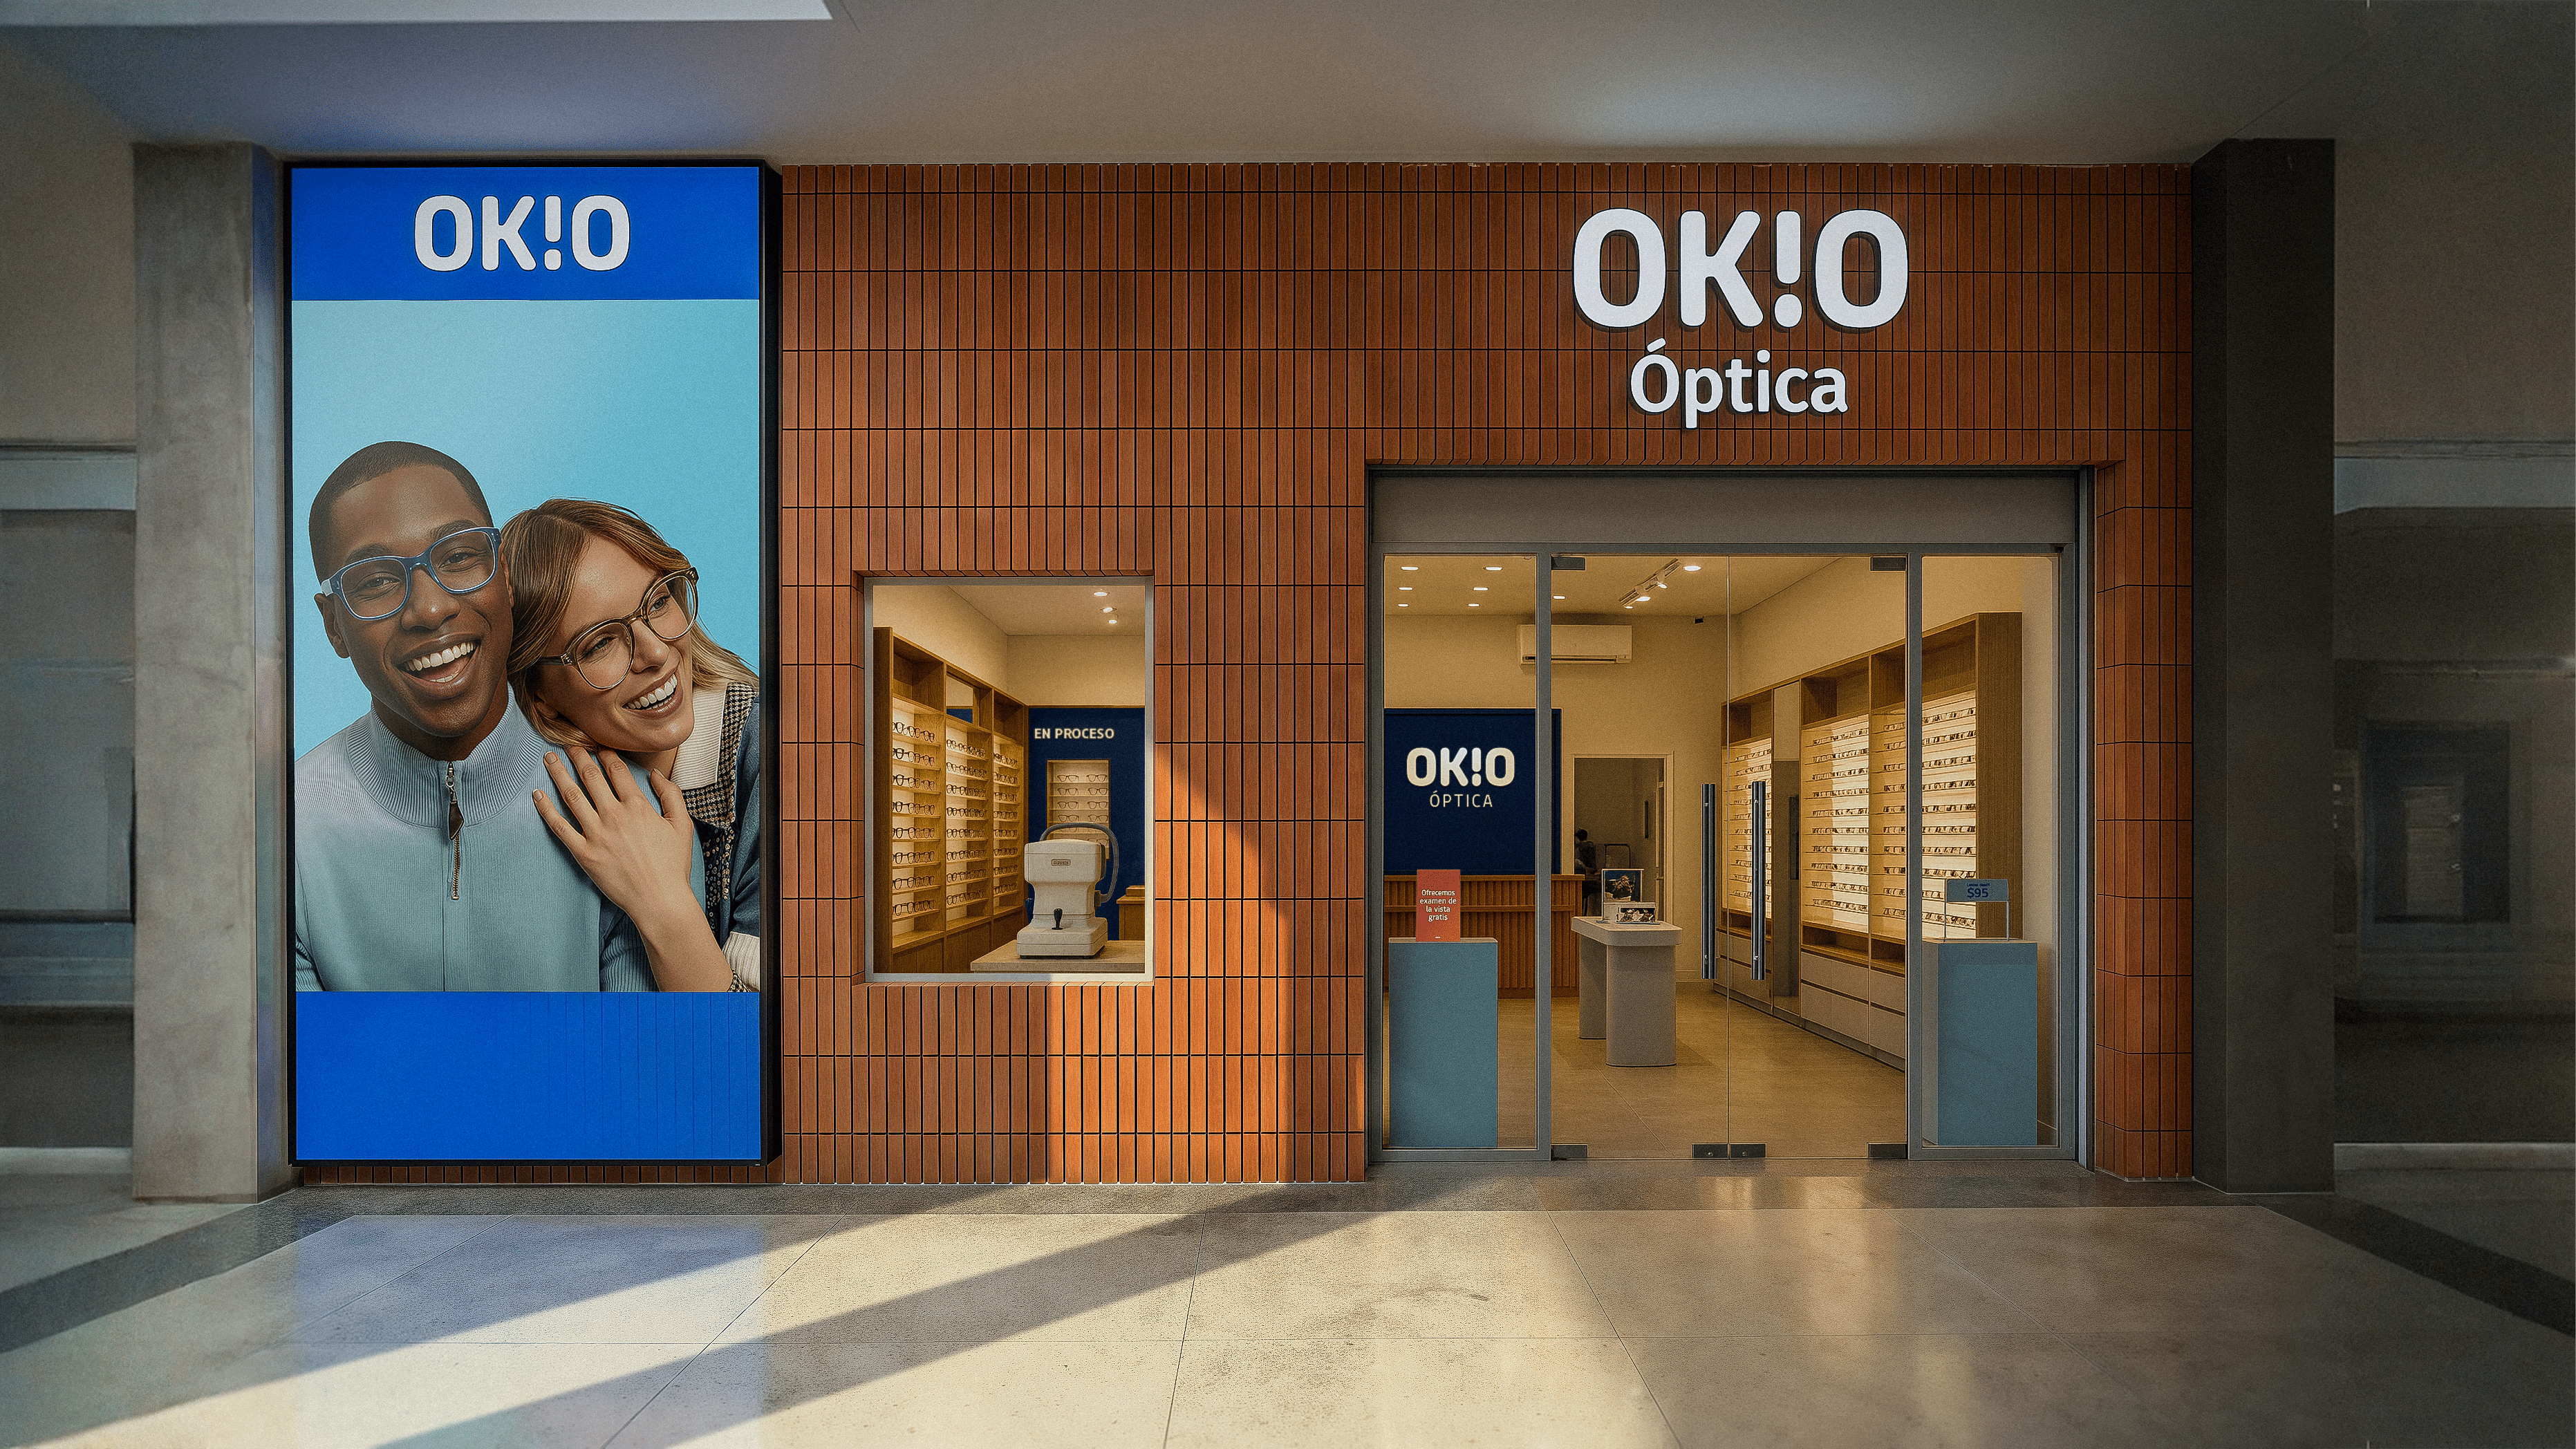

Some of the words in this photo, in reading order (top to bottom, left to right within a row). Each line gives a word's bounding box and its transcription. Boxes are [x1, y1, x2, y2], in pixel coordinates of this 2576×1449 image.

[414, 194, 630, 272] OK!O
[1573, 207, 1908, 328] OK!O
[1630, 337, 1849, 429] Óptica
[1034, 728, 1051, 739] EN
[1054, 728, 1114, 739] PROCESO
[1406, 747, 1515, 787] OK!O
[1430, 790, 1493, 807] ÓPTICA
[1967, 887, 1989, 899] $95
[1428, 913, 1448, 922] gratis
